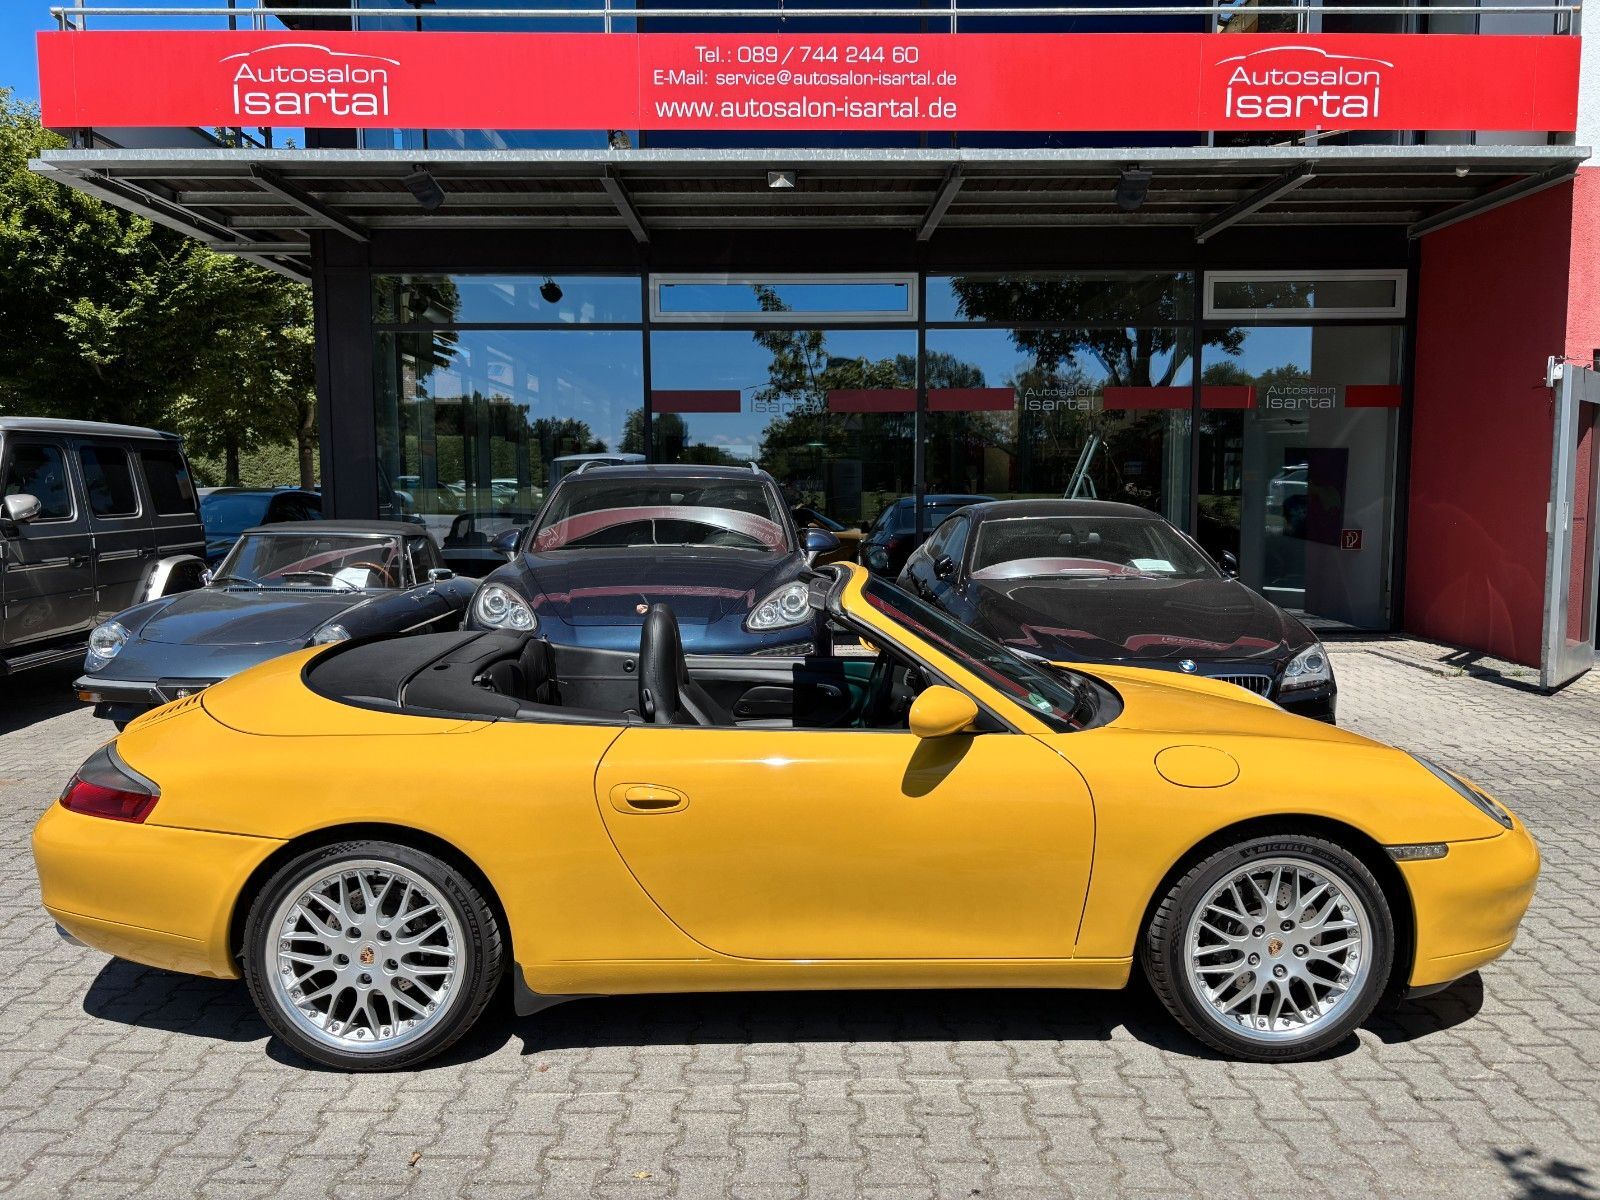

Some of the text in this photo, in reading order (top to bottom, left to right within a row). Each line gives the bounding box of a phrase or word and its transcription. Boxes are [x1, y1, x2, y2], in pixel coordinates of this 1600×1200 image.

[694, 46, 732, 63] Tel.:
[737, 46, 778, 63] 089
[799, 46, 838, 63] 744
[845, 46, 885, 63] 244
[891, 46, 919, 63] 60
[233, 63, 388, 83] Autosalon
[653, 69, 957, 86] E-Mail: service@autosalon-isartal.de
[1227, 66, 1380, 86] Autosalon
[232, 83, 389, 116] Isartal
[655, 96, 957, 119] www.autosalon-isartal.de
[1225, 86, 1380, 118] Isartal
[1266, 385, 1336, 395] Autosalon
[1024, 396, 1094, 411] Isartal
[1266, 394, 1336, 409] Isartal
[1257, 843, 1314, 854] MICHELIN
[452, 892, 481, 947] MICHELIN
